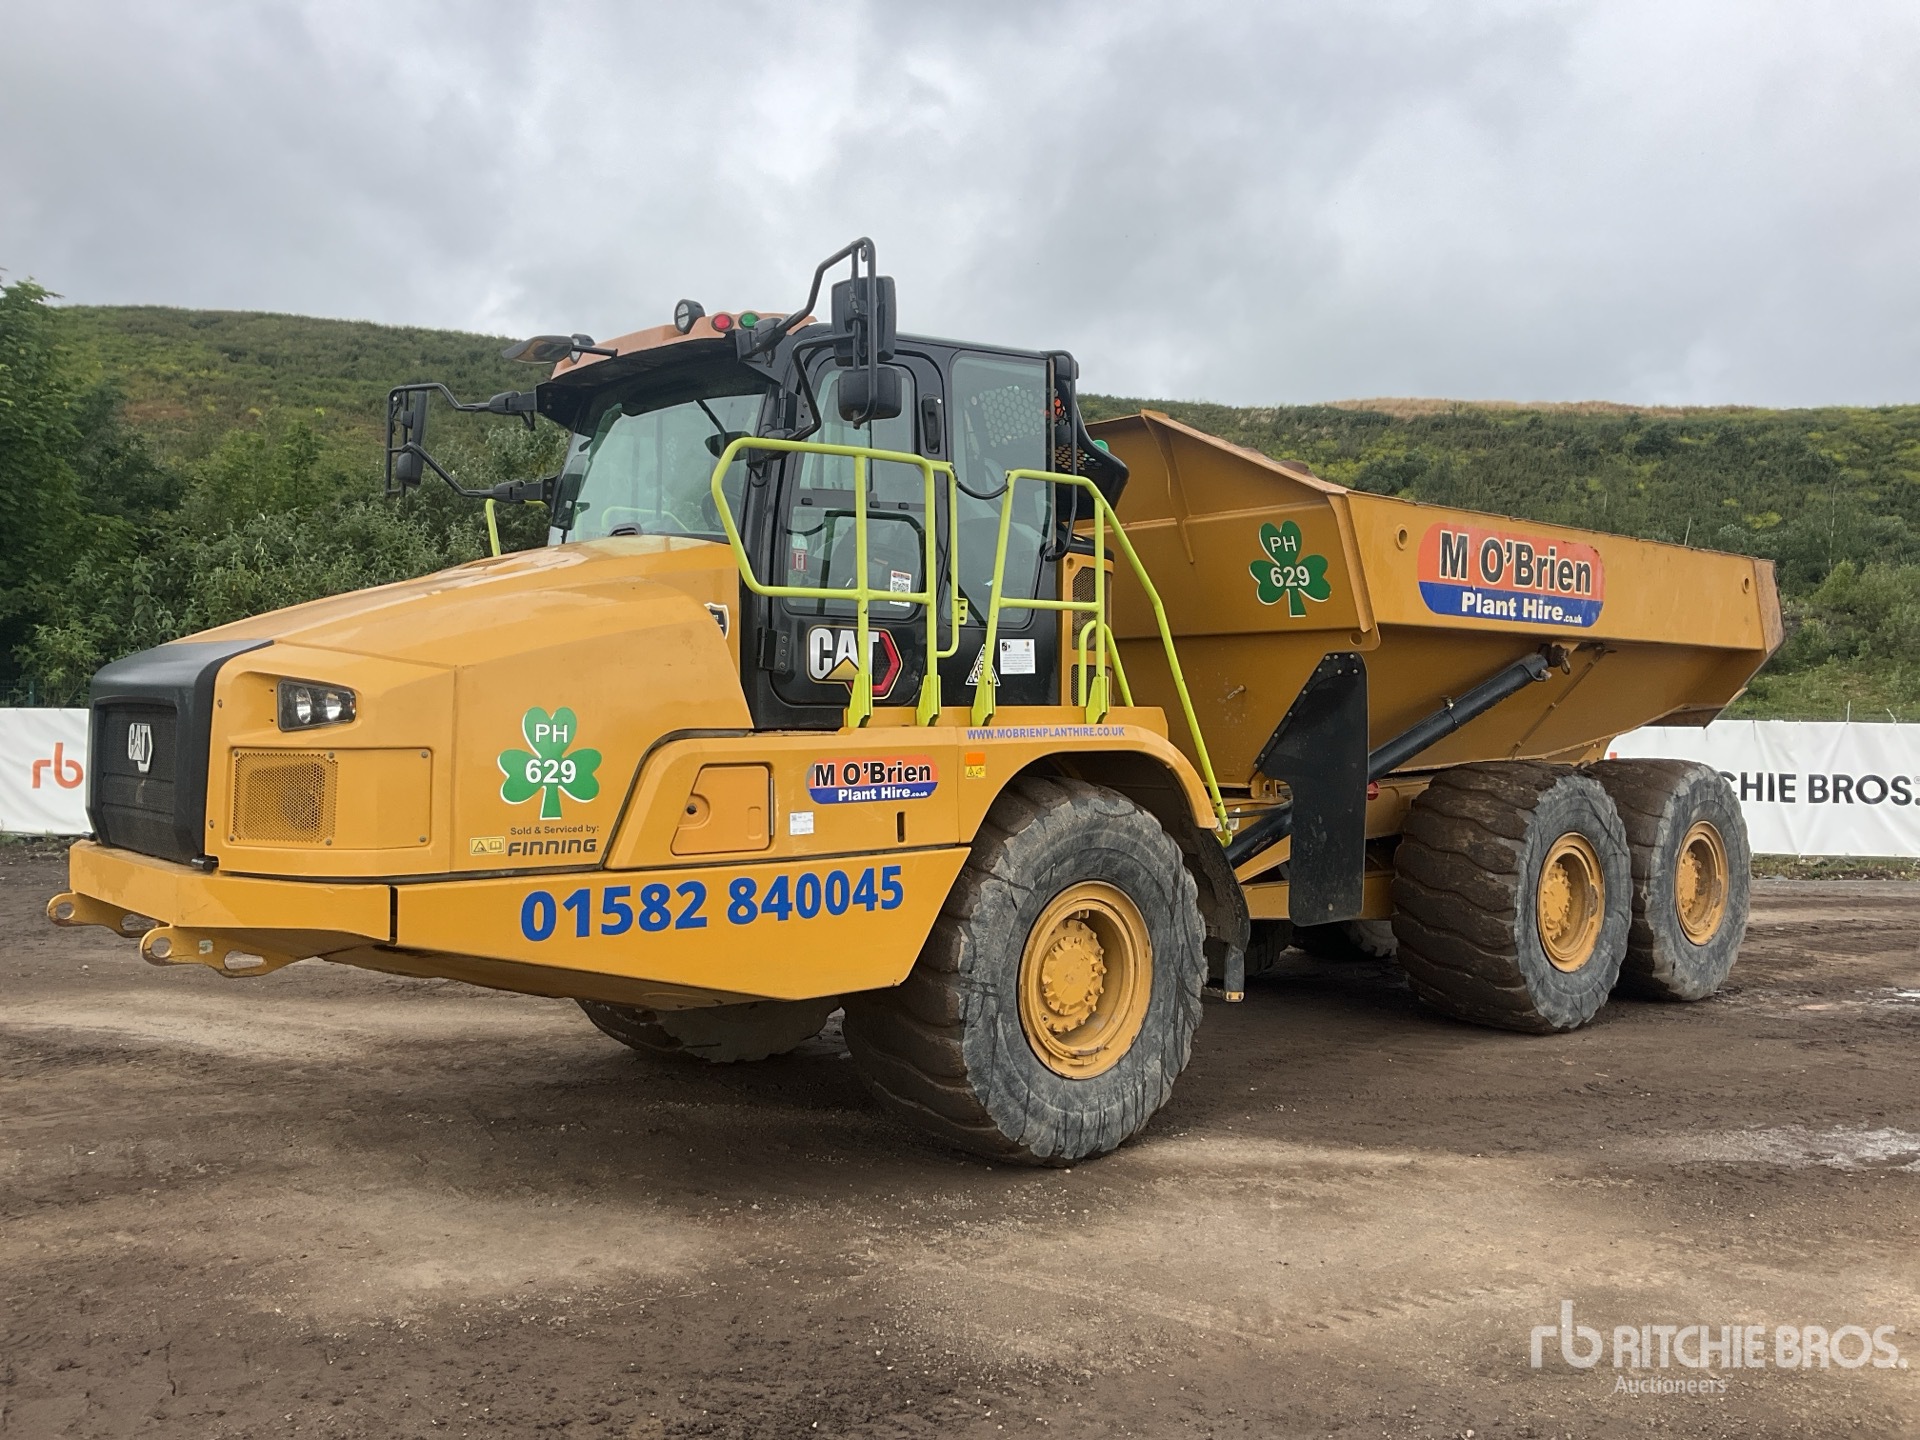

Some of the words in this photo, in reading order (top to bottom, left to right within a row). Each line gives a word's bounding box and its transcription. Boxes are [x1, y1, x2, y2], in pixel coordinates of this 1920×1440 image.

[1269, 535, 1297, 553] PH
[1439, 530, 1469, 581] M
[1270, 566, 1310, 588] 629
[1461, 591, 1517, 618] Plant
[128, 723, 148, 761] CAT
[534, 722, 569, 745] PH
[967, 726, 1126, 741] WWW.MOBRIENPLANTHIRE.CO.UK
[31, 742, 84, 790] rb
[524, 758, 578, 785] 629
[814, 764, 836, 788] M
[838, 786, 877, 801] Plant
[1720, 770, 1796, 803] HIE
[510, 827, 532, 835] Sold
[534, 826, 542, 834] &
[544, 825, 584, 834] Serviced
[585, 825, 600, 833] by:
[507, 838, 598, 857] FINNING
[521, 881, 708, 942] 01582
[727, 865, 904, 926] 840045
